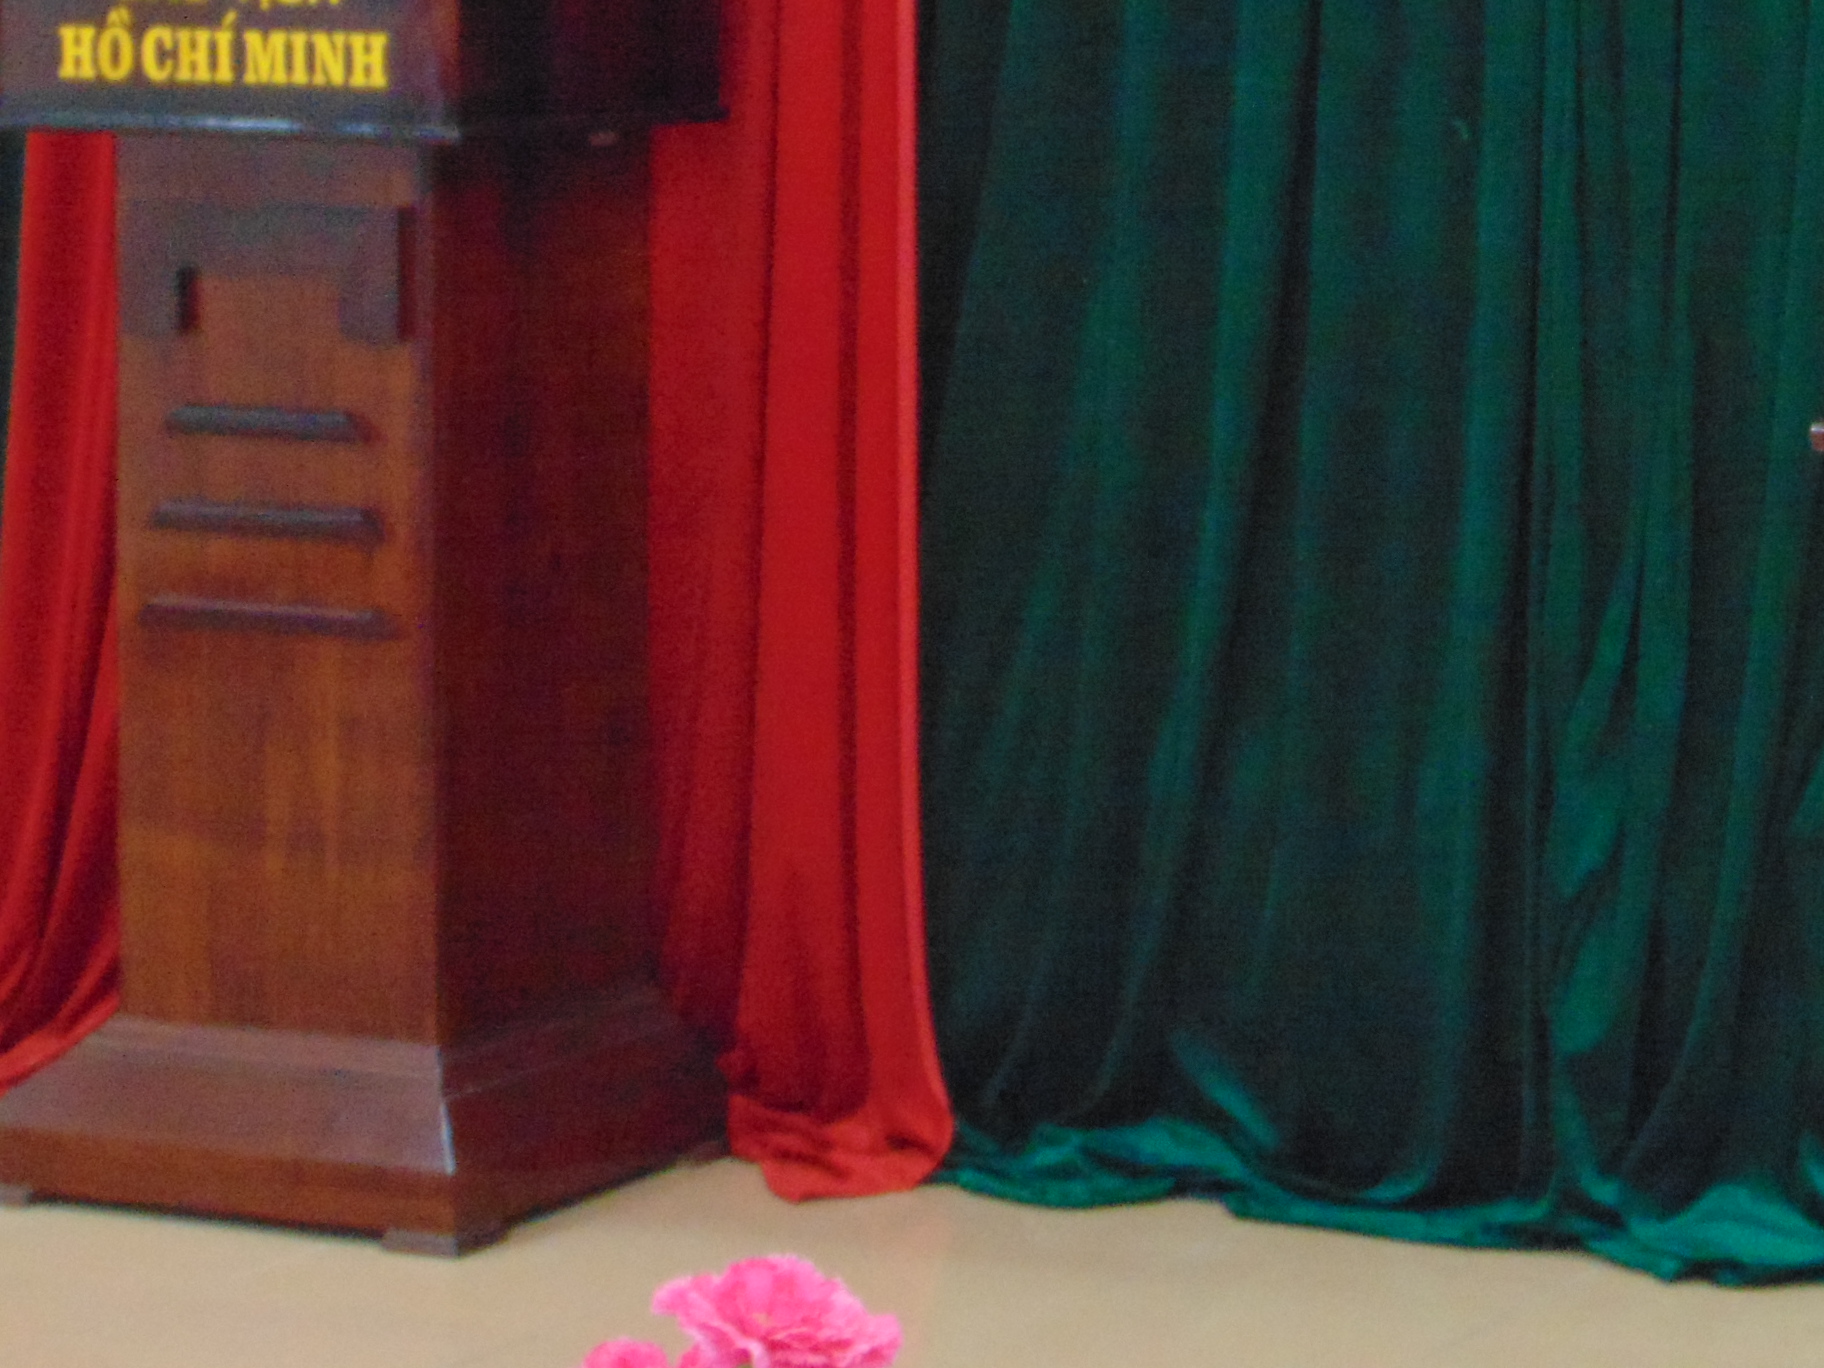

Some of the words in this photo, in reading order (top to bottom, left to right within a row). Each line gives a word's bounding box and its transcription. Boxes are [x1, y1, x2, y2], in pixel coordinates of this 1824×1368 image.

[57, 6, 134, 81] HỒ
[141, 10, 237, 85] CHÍ
[243, 30, 389, 89] MINH
